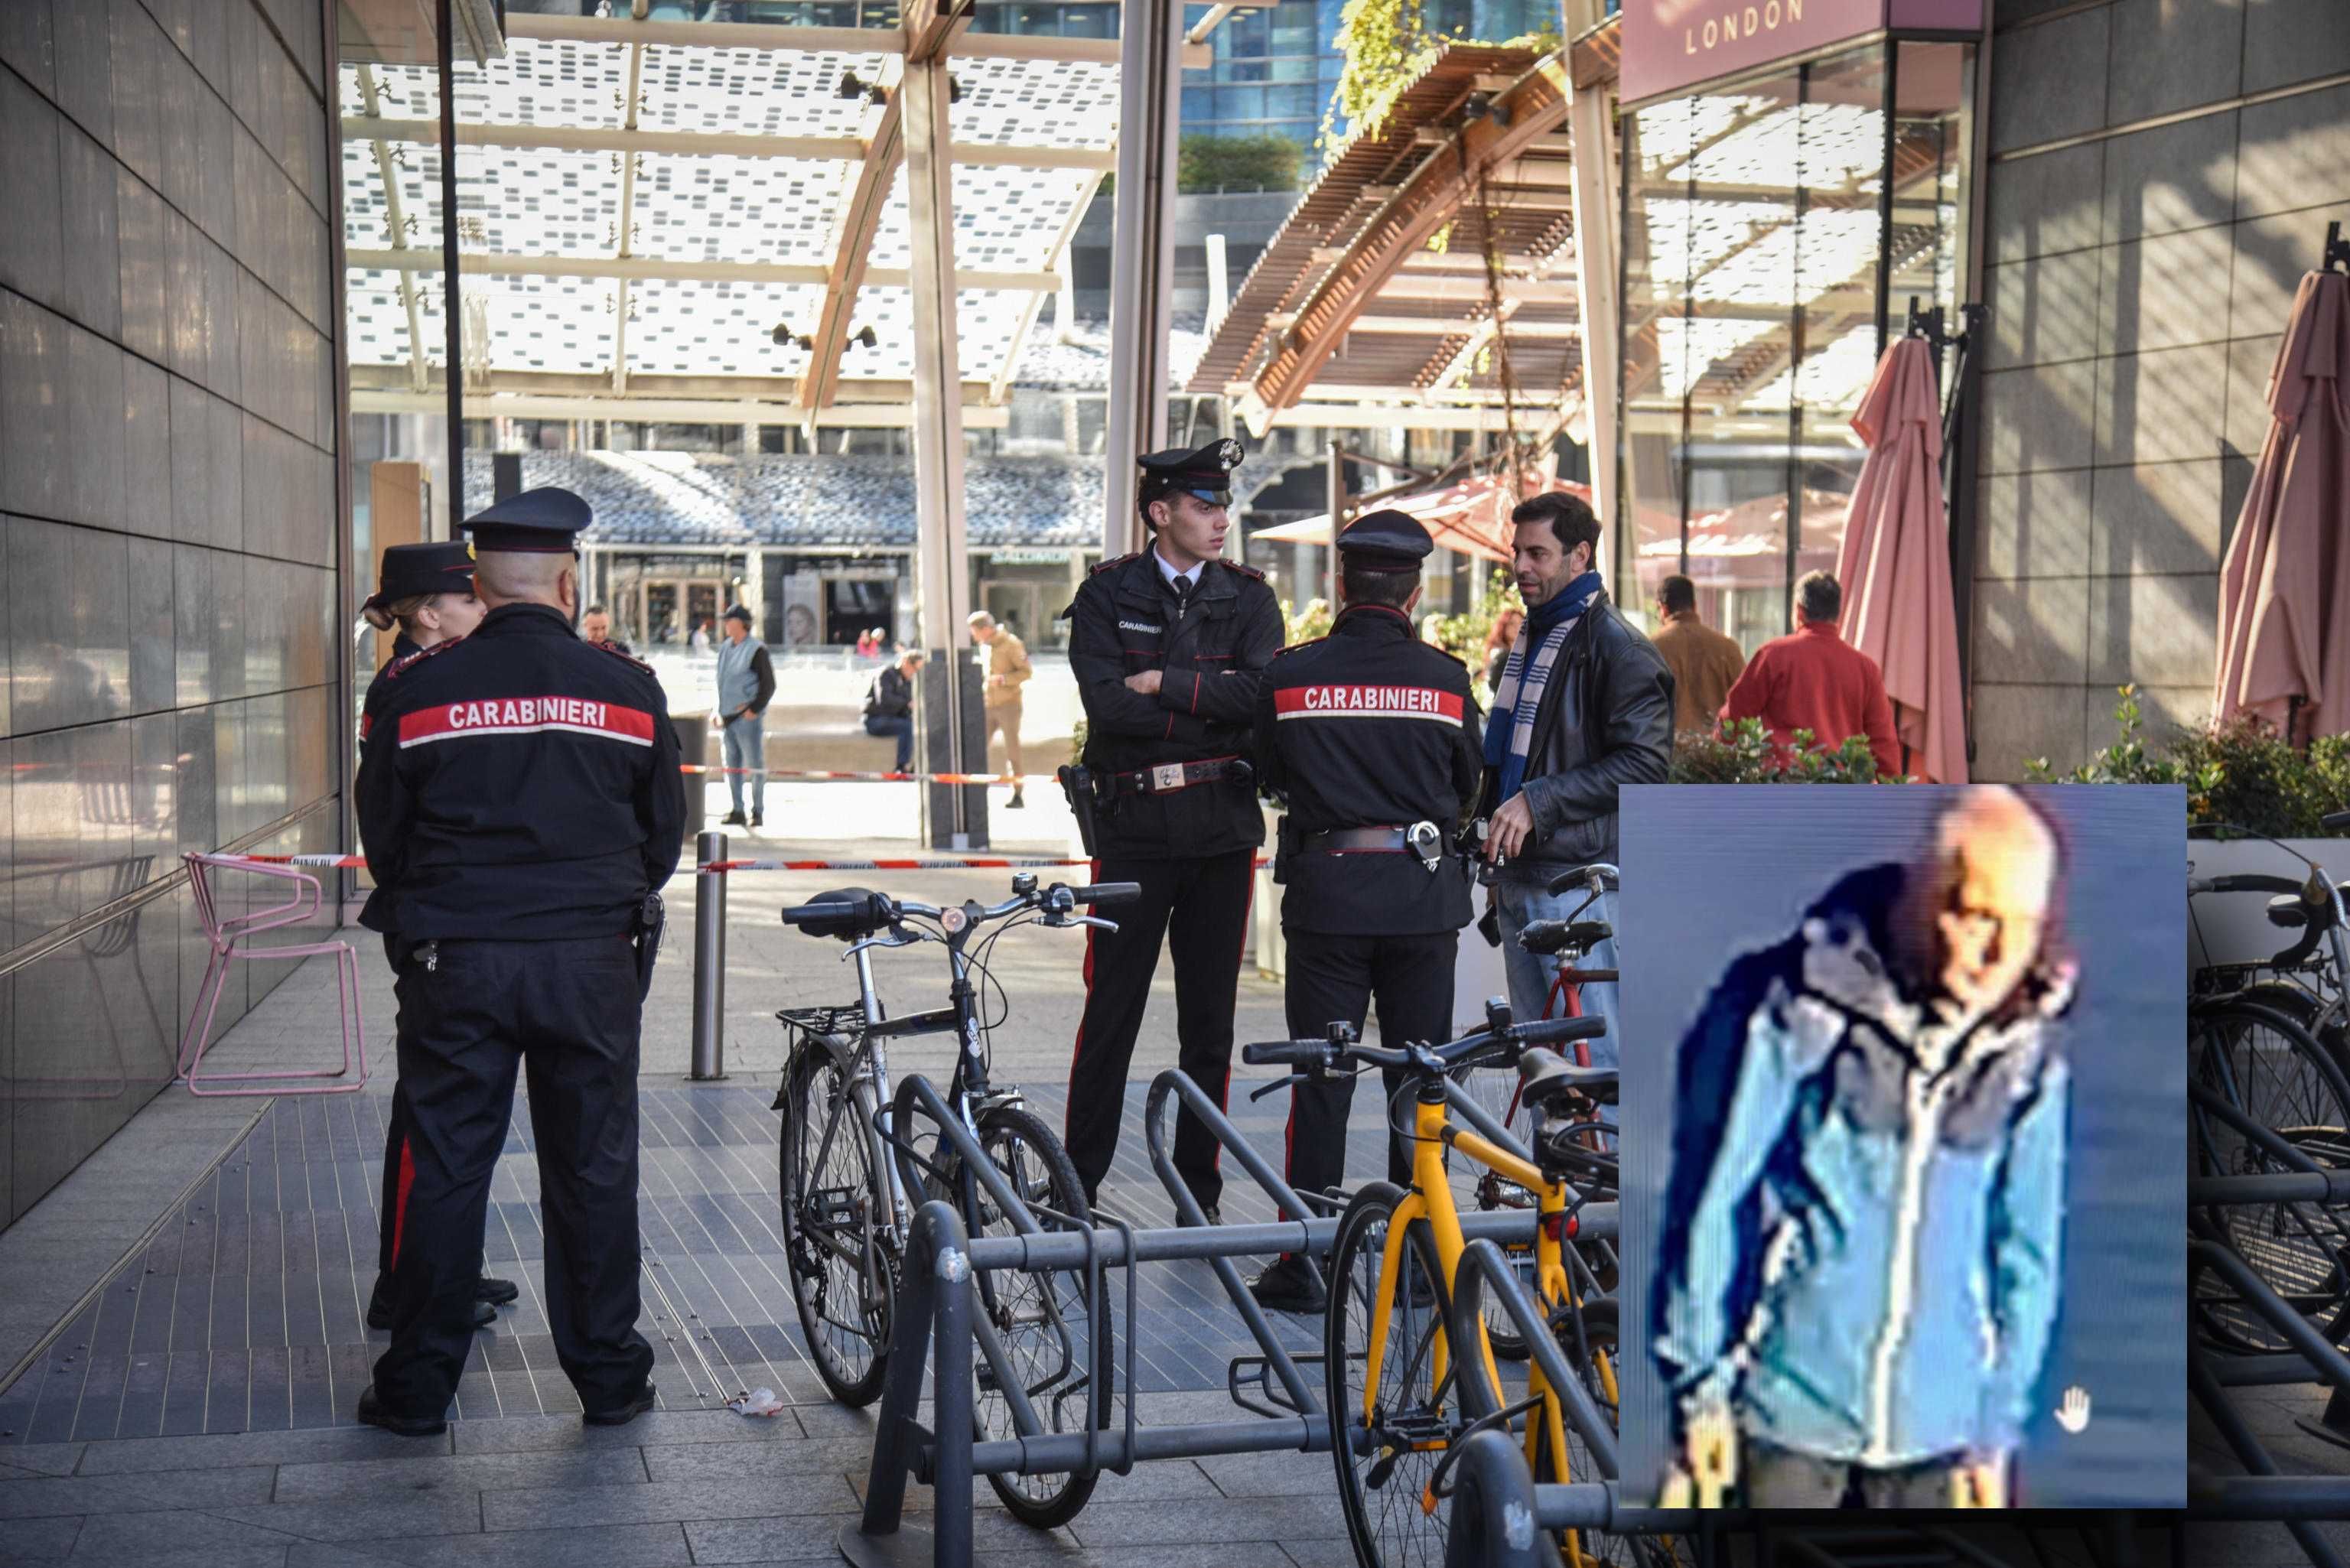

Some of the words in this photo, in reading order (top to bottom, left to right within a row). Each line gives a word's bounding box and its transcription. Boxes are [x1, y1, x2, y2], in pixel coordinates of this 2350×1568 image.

[1685, 0, 1802, 54] LONDON
[1118, 620, 1162, 634] CARABINIER
[449, 698, 606, 728] CARABINIERI
[1304, 688, 1439, 712] CARABINIERI
